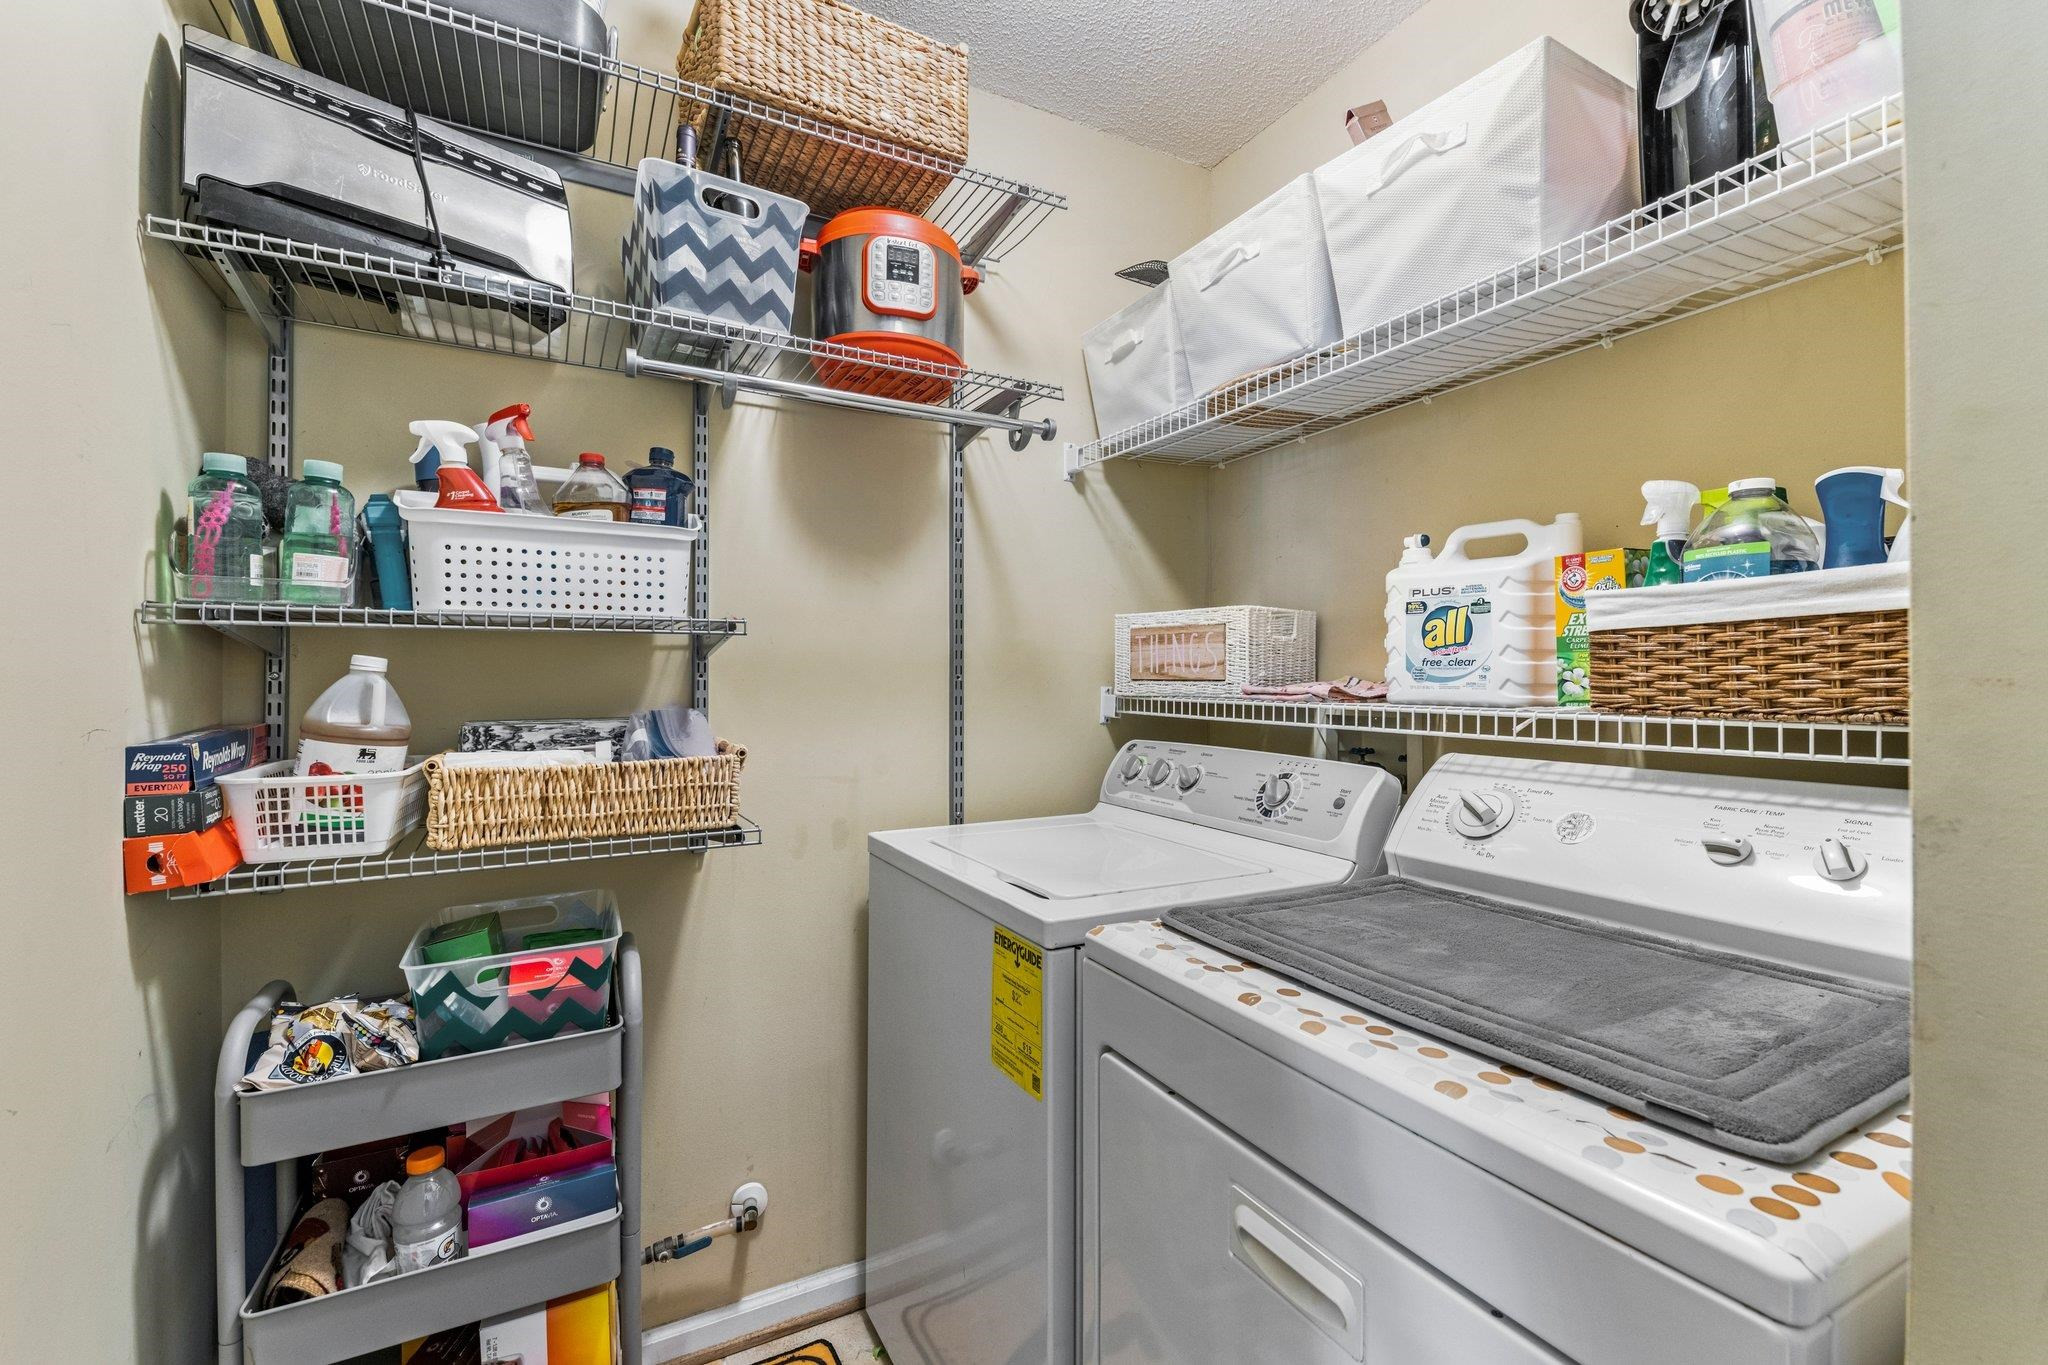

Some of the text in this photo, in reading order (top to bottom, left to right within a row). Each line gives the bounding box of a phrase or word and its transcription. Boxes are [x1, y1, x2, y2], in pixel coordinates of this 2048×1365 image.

[1423, 605, 1469, 650] all
[1135, 631, 1218, 673] THINGS
[1422, 658, 1476, 666] free clear
[133, 752, 187, 763] Reynolds
[202, 741, 246, 773] Reynolds Wrap
[130, 761, 162, 772] Wrap
[162, 764, 187, 773] 250
[134, 784, 183, 792] EVERYDAY
[176, 797, 184, 812] bags
[1714, 804, 1738, 812] FABRIC
[154, 807, 169, 823] 20
[1844, 819, 1873, 827] SIGNAL
[994, 930, 1042, 970] ENERGYGUIDE
